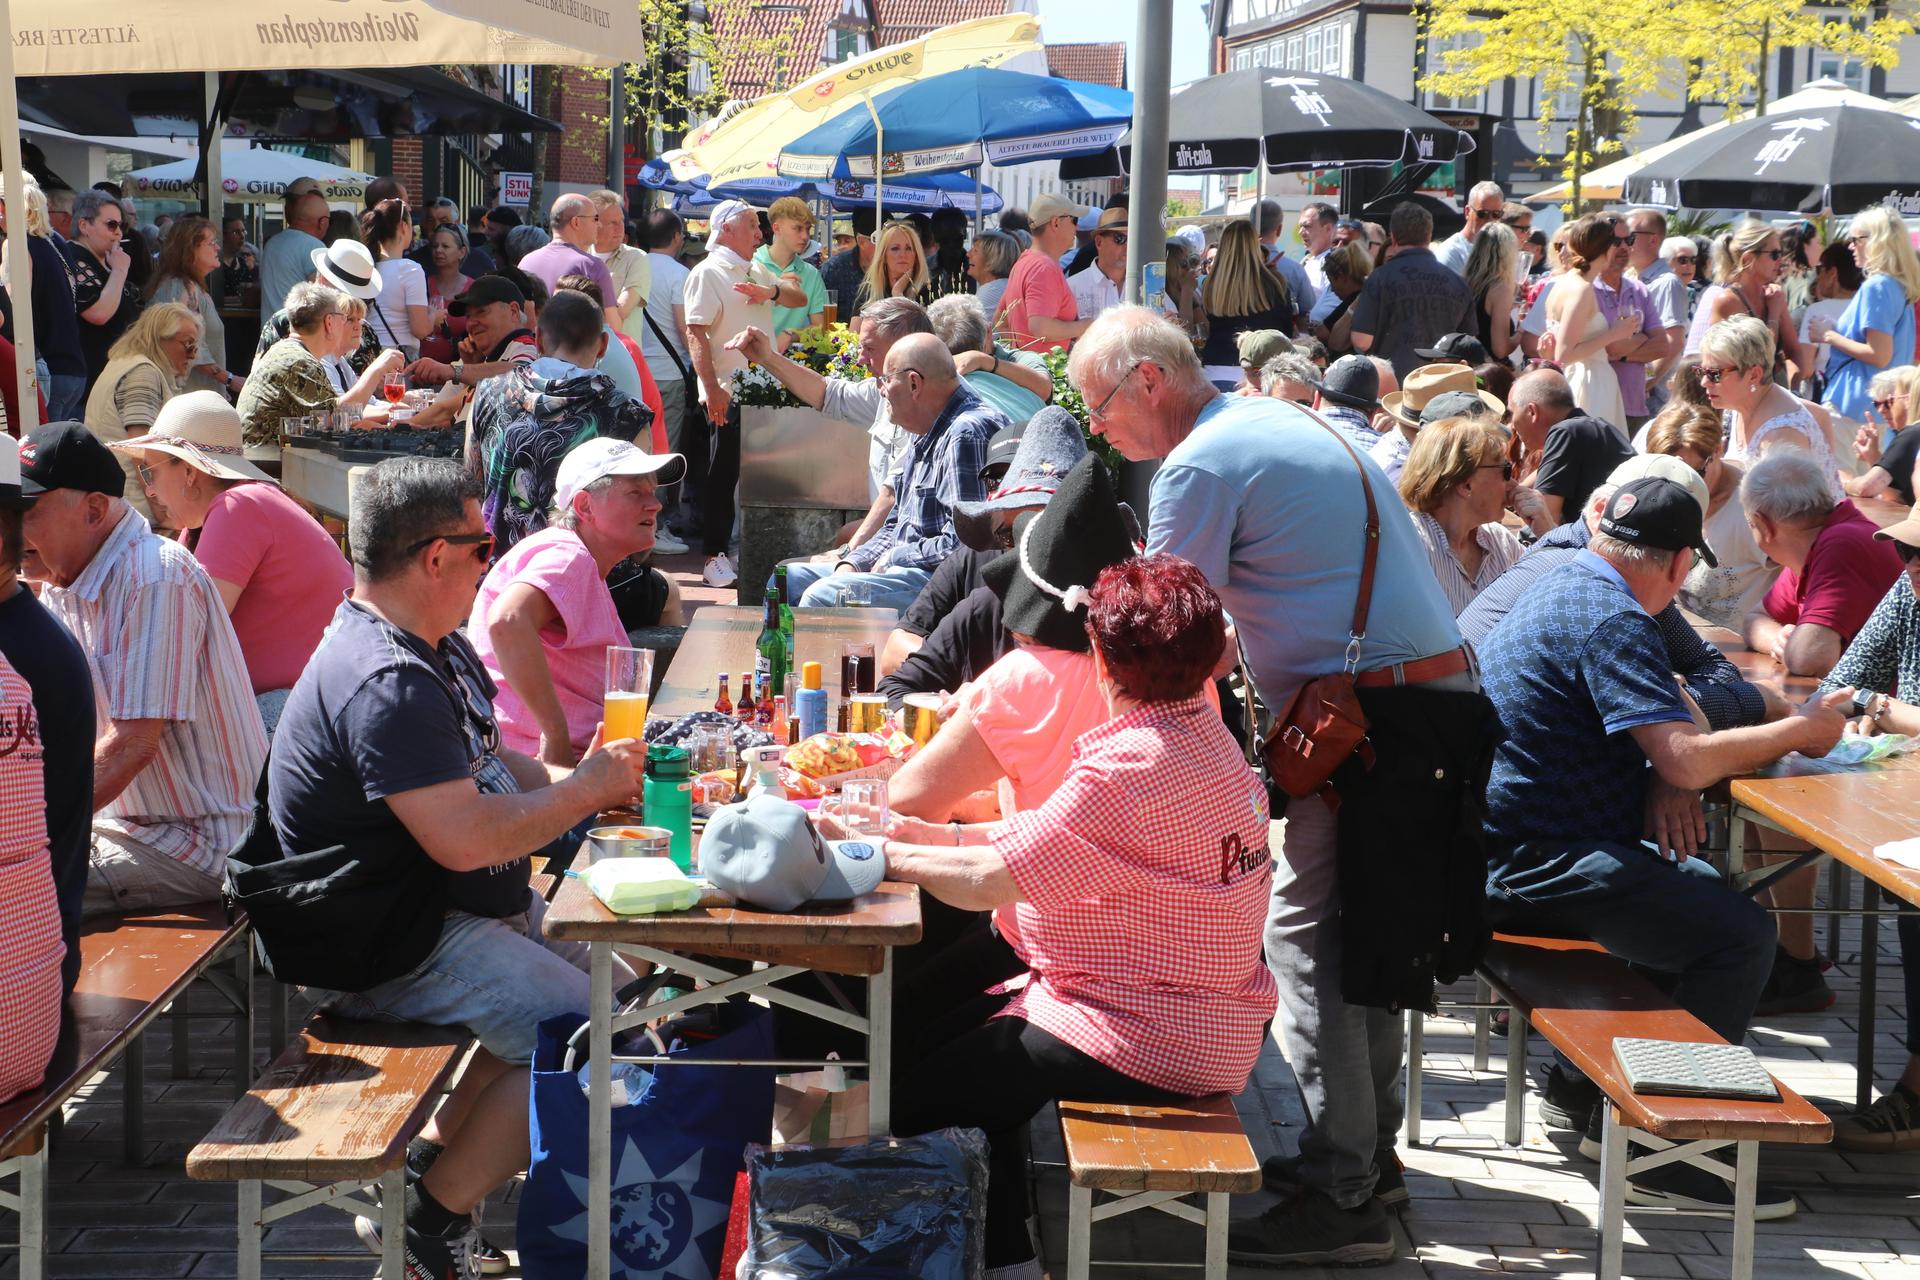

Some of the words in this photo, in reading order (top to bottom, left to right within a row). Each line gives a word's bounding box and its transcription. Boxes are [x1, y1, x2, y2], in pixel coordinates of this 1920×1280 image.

[999, 143, 1031, 154] ÄLTESTE
[1032, 138, 1070, 150] BRAUEREI
[1071, 135, 1089, 144] DER
[1090, 133, 1114, 142] WELT
[913, 150, 965, 167] Weihenstephan
[1176, 143, 1213, 167] afri-cola
[247, 180, 288, 194] Gild
[508, 179, 532, 190] STIL
[505, 189, 529, 198] PUNK
[1615, 525, 1640, 536] 1896
[405, 1245, 418, 1265] AMP
